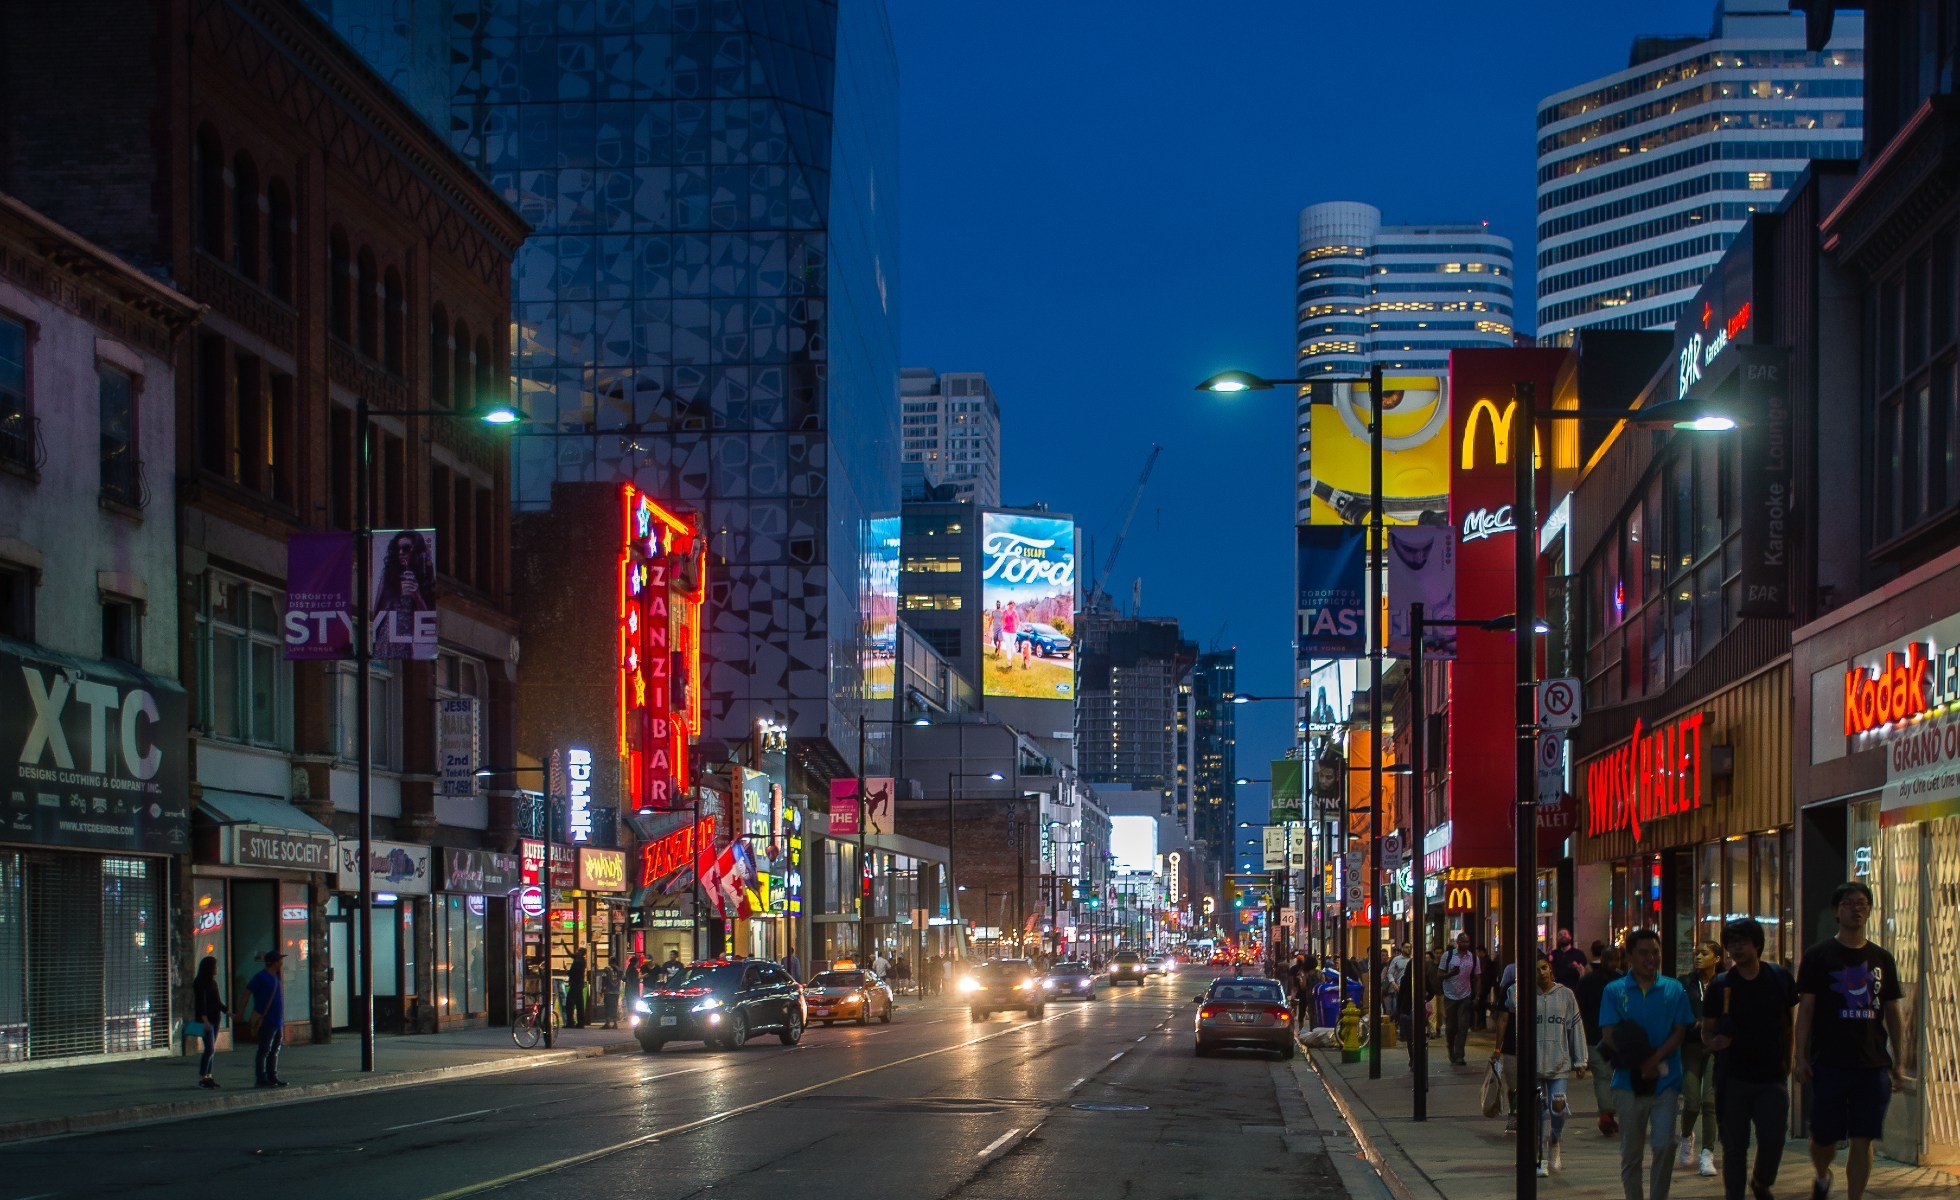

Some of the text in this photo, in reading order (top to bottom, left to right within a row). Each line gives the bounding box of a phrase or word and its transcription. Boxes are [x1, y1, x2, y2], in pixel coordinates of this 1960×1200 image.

[1678, 332, 1702, 401] BAR
[1748, 364, 1777, 380] BAR
[1764, 398, 1788, 566] Karaoke Lounge
[983, 532, 1074, 587] Ford
[1023, 547, 1046, 558] ESCAPE
[1301, 589, 1356, 597] TORONTO'S
[1301, 598, 1361, 606] DISTRICT OF
[1748, 584, 1777, 603] BAR
[285, 610, 438, 646] STYLE
[649, 565, 668, 801] ZANZIBAR
[1844, 642, 1927, 736] Kodak
[444, 701, 471, 712] JESSI
[18, 665, 163, 781] XTC
[447, 754, 469, 766] 2nd
[1893, 727, 1941, 773] GRAND
[18, 766, 57, 782] DESIGNS
[59, 771, 101, 787] CLOTHING
[103, 777, 109, 789] &
[110, 778, 146, 792] COMPANY
[1588, 710, 1703, 840] SWISS CHALET
[1913, 778, 1926, 795] One
[1927, 774, 1940, 791] Get
[569, 749, 592, 841] BUFFET
[59, 820, 135, 836] WWW.XTCDESIGNS.COM
[829, 813, 853, 824] THE
[1536, 813, 1569, 829] ALET
[250, 837, 323, 863] STYLE SOCIETY
[523, 842, 575, 863] BUFFE PALACE
[1070, 819, 1082, 899] WINNERS
[1282, 915, 1294, 924] 40
